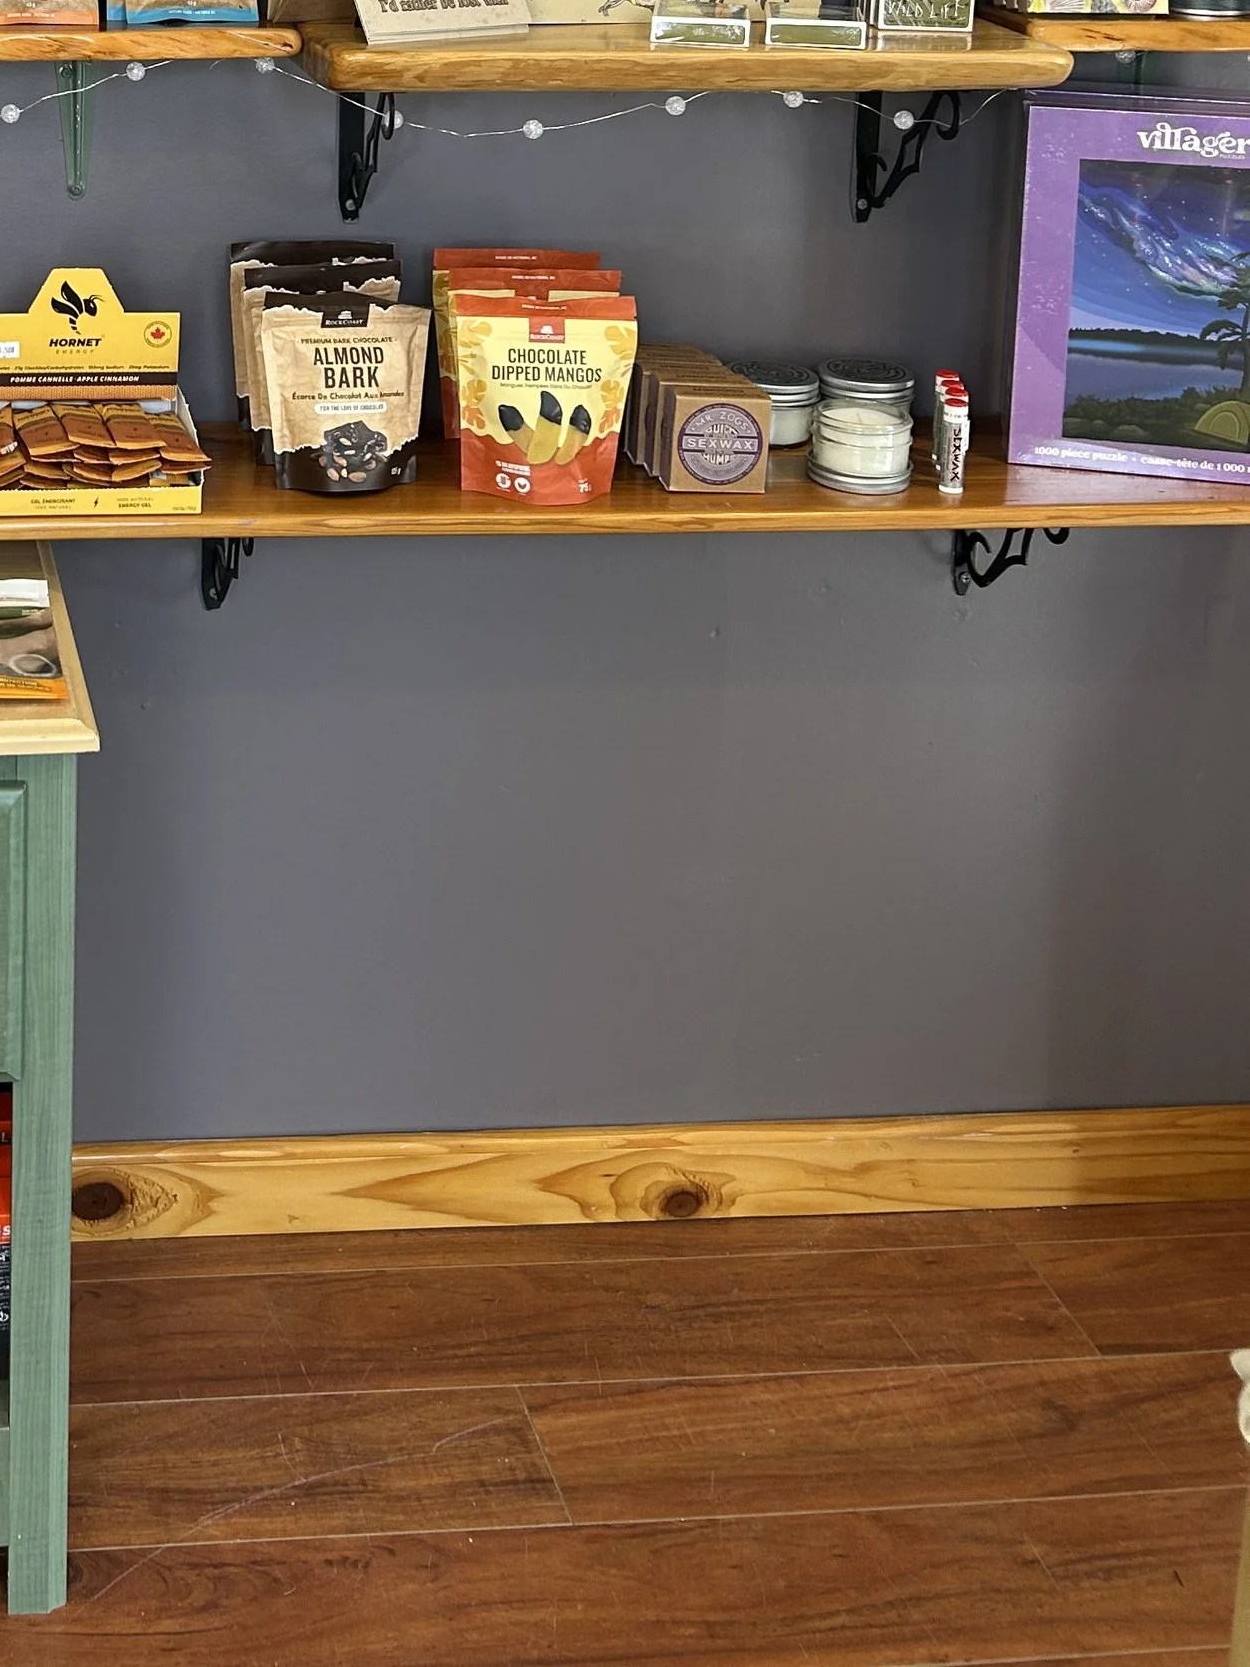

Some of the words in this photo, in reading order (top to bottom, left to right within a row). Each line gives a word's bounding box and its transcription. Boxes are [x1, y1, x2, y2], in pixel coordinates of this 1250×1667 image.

[49, 338, 101, 347] HORNET
[314, 347, 384, 365] ALMOND
[508, 348, 587, 365] CHOCOLATE
[324, 366, 380, 389] BARK
[492, 365, 541, 381] DIPPED
[545, 367, 602, 383] MANGOS
[292, 392, 315, 400] Écorce
[330, 392, 362, 400] Chocolat
[720, 411, 749, 430] ZOGS
[687, 438, 753, 450] SEXWAX
[951, 429, 962, 481] SEXWAX
[1034, 446, 1059, 456] 1000
[1061, 449, 1091, 459] piece
[1092, 452, 1128, 462] puzzle
[1141, 455, 1198, 469] casse-tête
[1200, 460, 1214, 470] de
